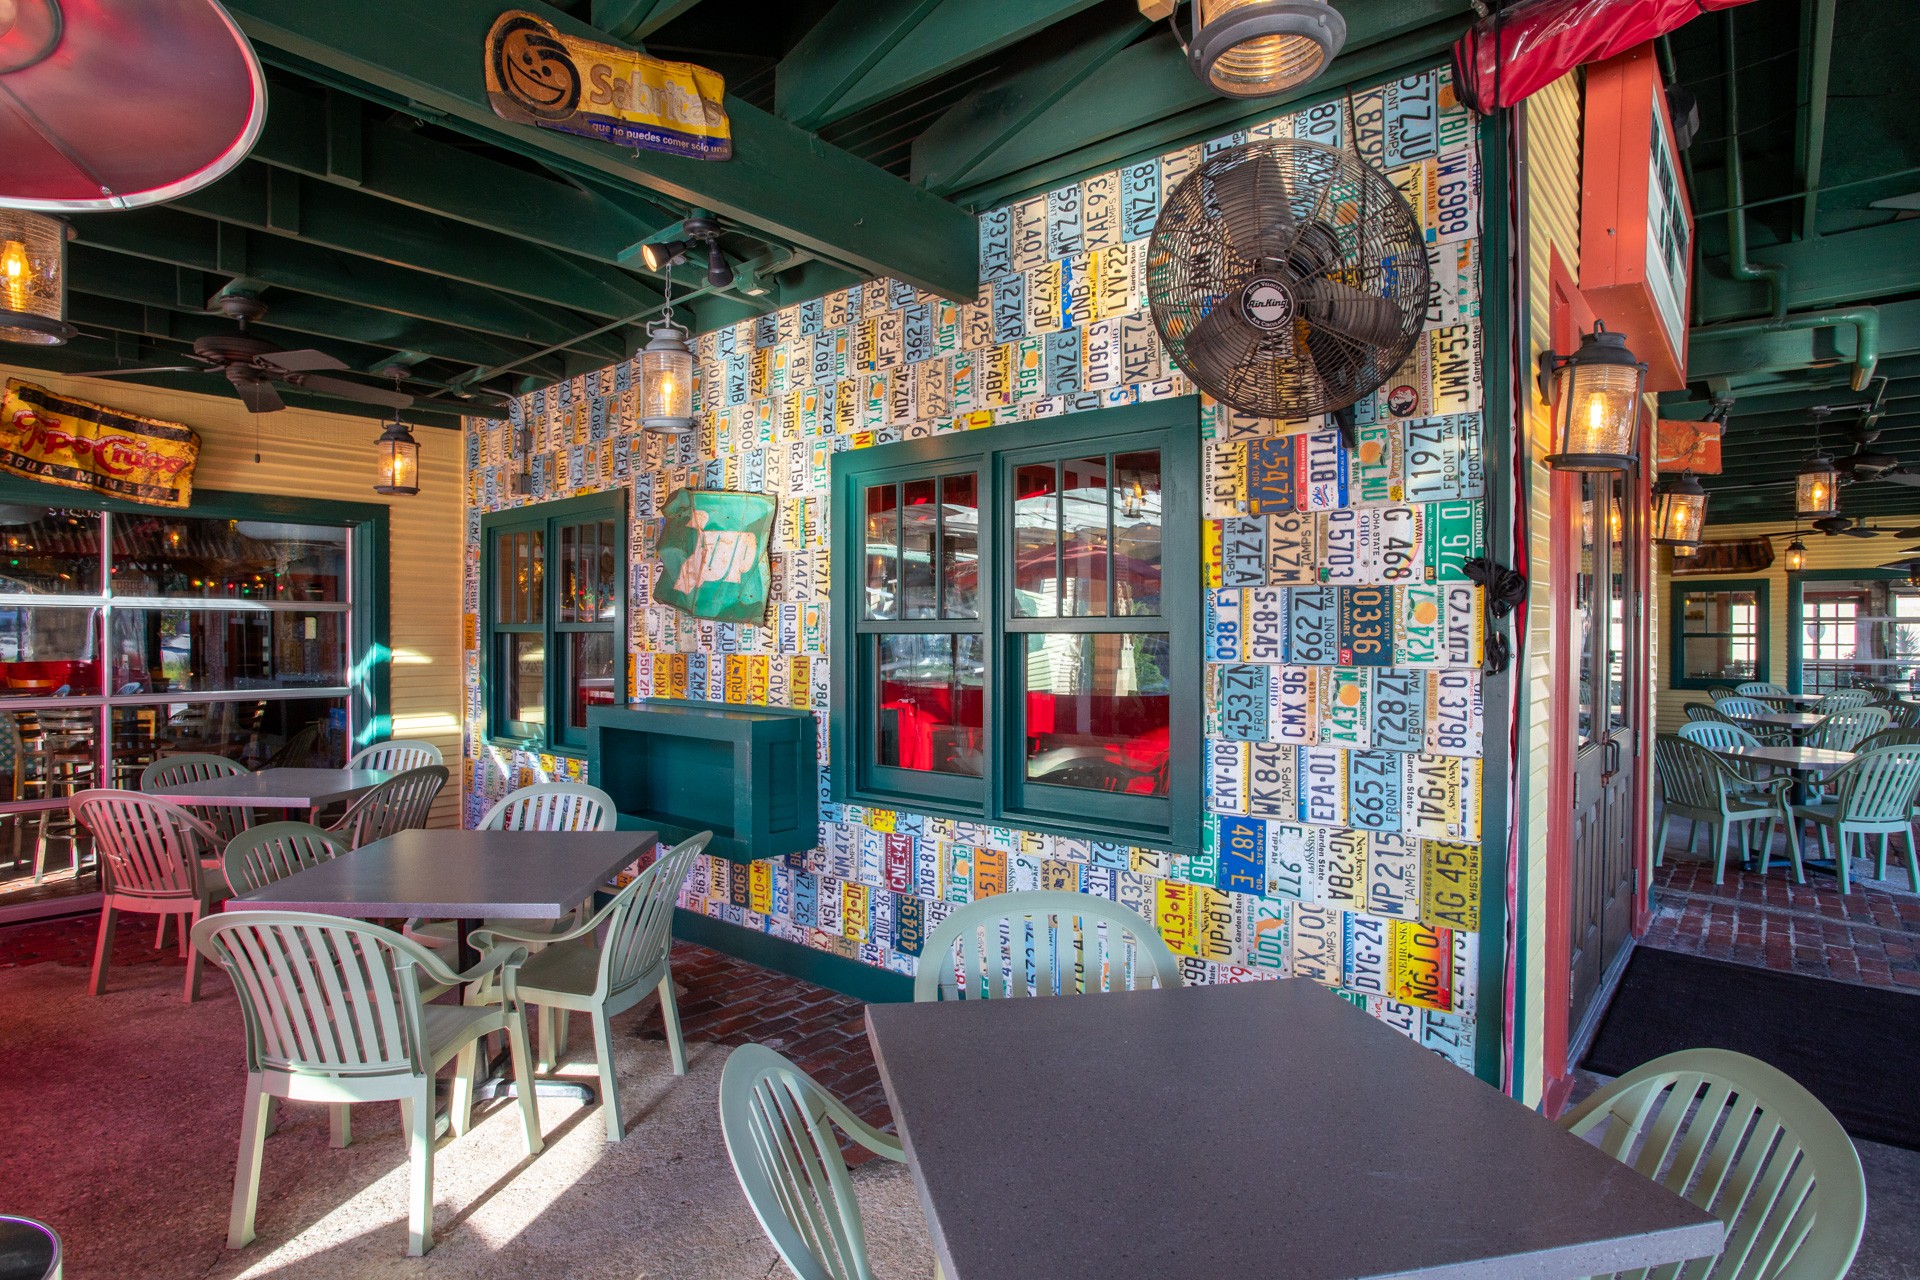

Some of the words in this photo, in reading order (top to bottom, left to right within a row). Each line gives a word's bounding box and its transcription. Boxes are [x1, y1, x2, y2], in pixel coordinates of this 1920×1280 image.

[589, 63, 723, 128] Sabritas
[592, 123, 610, 136] que
[612, 127, 624, 137] no
[626, 129, 661, 144] puedes
[662, 135, 690, 149] comer
[711, 145, 728, 154] una
[1388, 118, 1400, 157] TAMPS
[1428, 170, 1436, 210] HAMILTON
[1438, 180, 1469, 236] 6989
[1014, 206, 1022, 236] TAMPS
[1109, 198, 1117, 231] TAMPS
[1123, 201, 1132, 234] TAMPS
[1112, 328, 1120, 355] OHIO
[1387, 423, 1402, 480] FLORIDA
[1443, 449, 1454, 490] FRONT
[1468, 447, 1479, 489] FRONT
[1, 453, 54, 476] AGUA
[75, 470, 176, 501] MINERAL
[1360, 515, 1369, 547] OHIO
[1475, 501, 1485, 549] Vermont
[1226, 541, 1235, 577] TAMPS
[1301, 530, 1312, 567] TAMPS
[1328, 529, 1355, 578] 5703
[1383, 537, 1413, 580] 468
[1206, 589, 1216, 637] Kentucky
[1216, 622, 1238, 660] 038
[1324, 617, 1335, 655] FRONT
[1407, 626, 1435, 663] K24
[1270, 676, 1278, 706] OHIO
[1254, 695, 1263, 731] FRONT
[1281, 702, 1306, 738] CMX
[1408, 703, 1420, 742] FRONT
[1438, 697, 1468, 748] 3798
[1407, 753, 1415, 779] Garden
[1449, 759, 1459, 780] New
[1282, 767, 1292, 803] TAMPS
[1386, 782, 1397, 822] FRONT
[1406, 785, 1414, 809] State
[1447, 780, 1459, 810] Jersey
[1256, 825, 1264, 866] KANSAS
[1318, 828, 1326, 858] Garden
[1356, 836, 1365, 849] New
[1279, 861, 1302, 898] 977
[1318, 859, 1326, 881] State
[1355, 855, 1366, 884] Jersey
[1405, 863, 1416, 902] TAMPS
[1469, 845, 1478, 901] WISCONSIN
[1201, 891, 1210, 914] Jersey
[1435, 891, 1466, 924] AG
[1202, 916, 1210, 934] New
[1326, 931, 1336, 967] TAMPS
[1413, 956, 1440, 1003] NGJ
